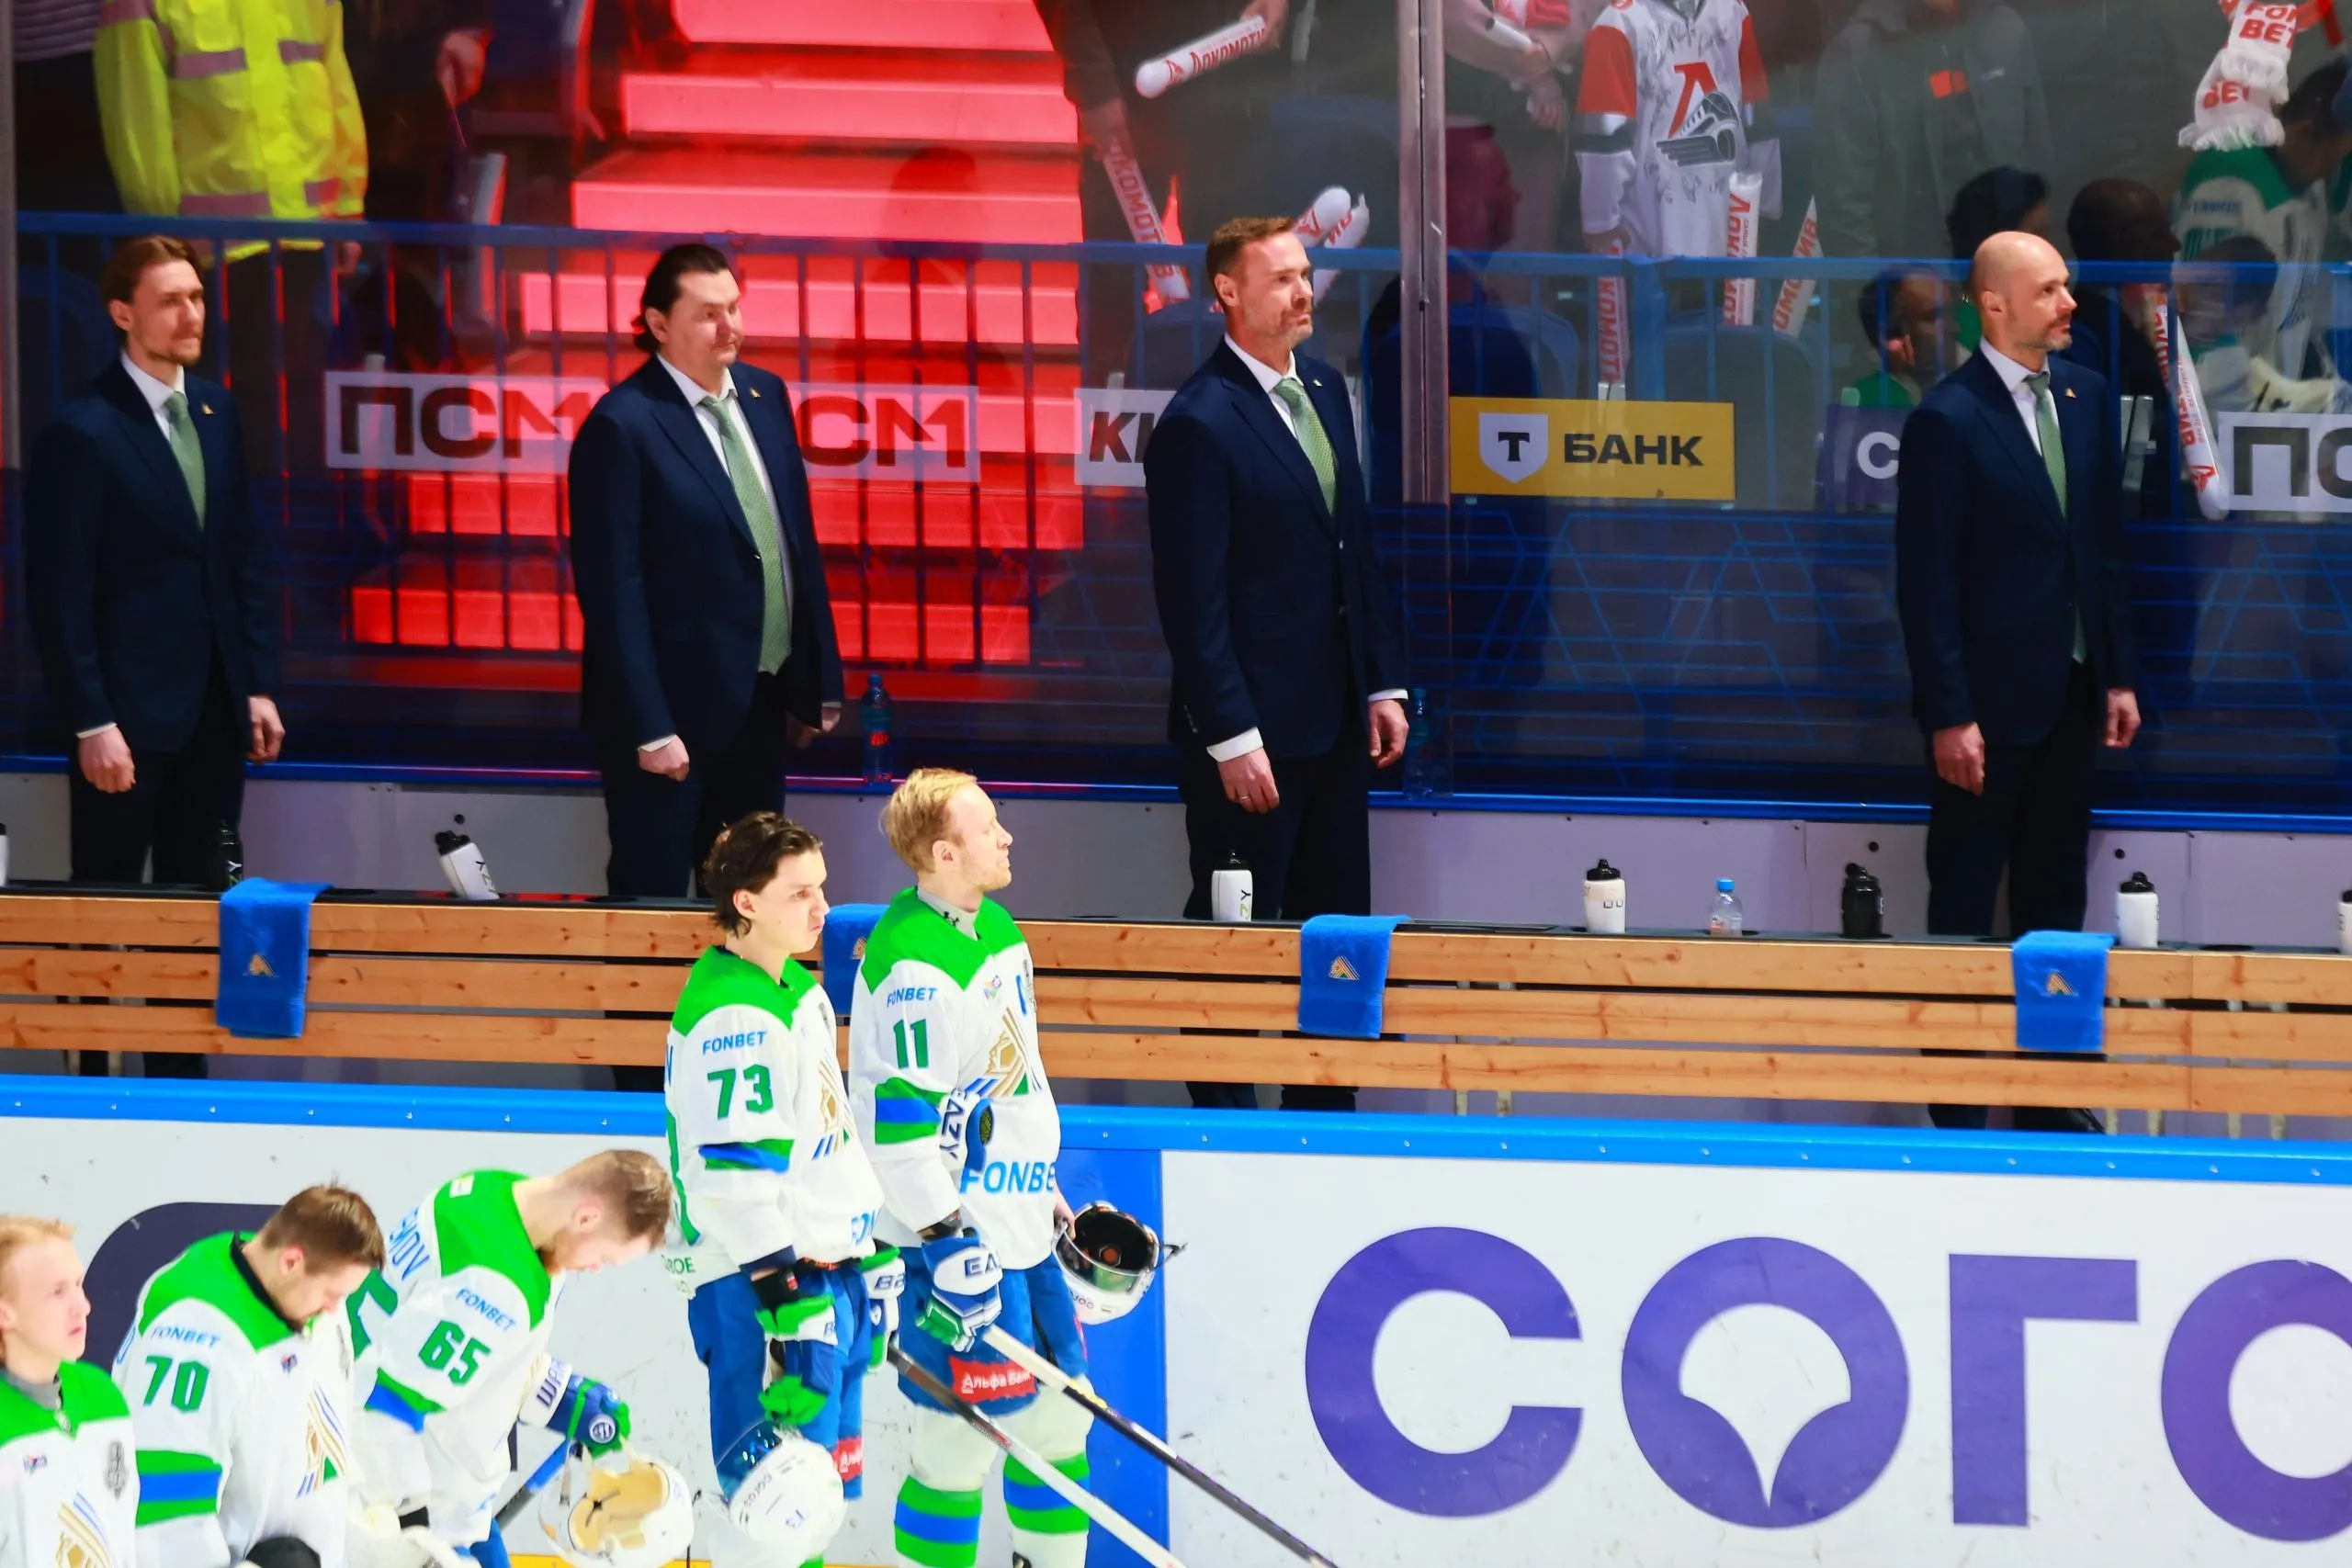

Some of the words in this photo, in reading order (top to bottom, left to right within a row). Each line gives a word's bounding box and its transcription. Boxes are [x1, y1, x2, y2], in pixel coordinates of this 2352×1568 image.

[797, 395, 967, 468] СМ
[1564, 433, 1704, 467] БАНК
[887, 987, 939, 1009] FONBET
[702, 1031, 767, 1056] FONBET
[893, 1018, 929, 1069] 11
[707, 1064, 774, 1121] 73
[959, 1161, 1057, 1195] FONBE
[455, 1288, 517, 1331] FONBET
[151, 1325, 220, 1348] FONBET
[417, 1319, 492, 1387] 65
[142, 1355, 210, 1413] 70
[962, 1371, 1007, 1394] Альфа
